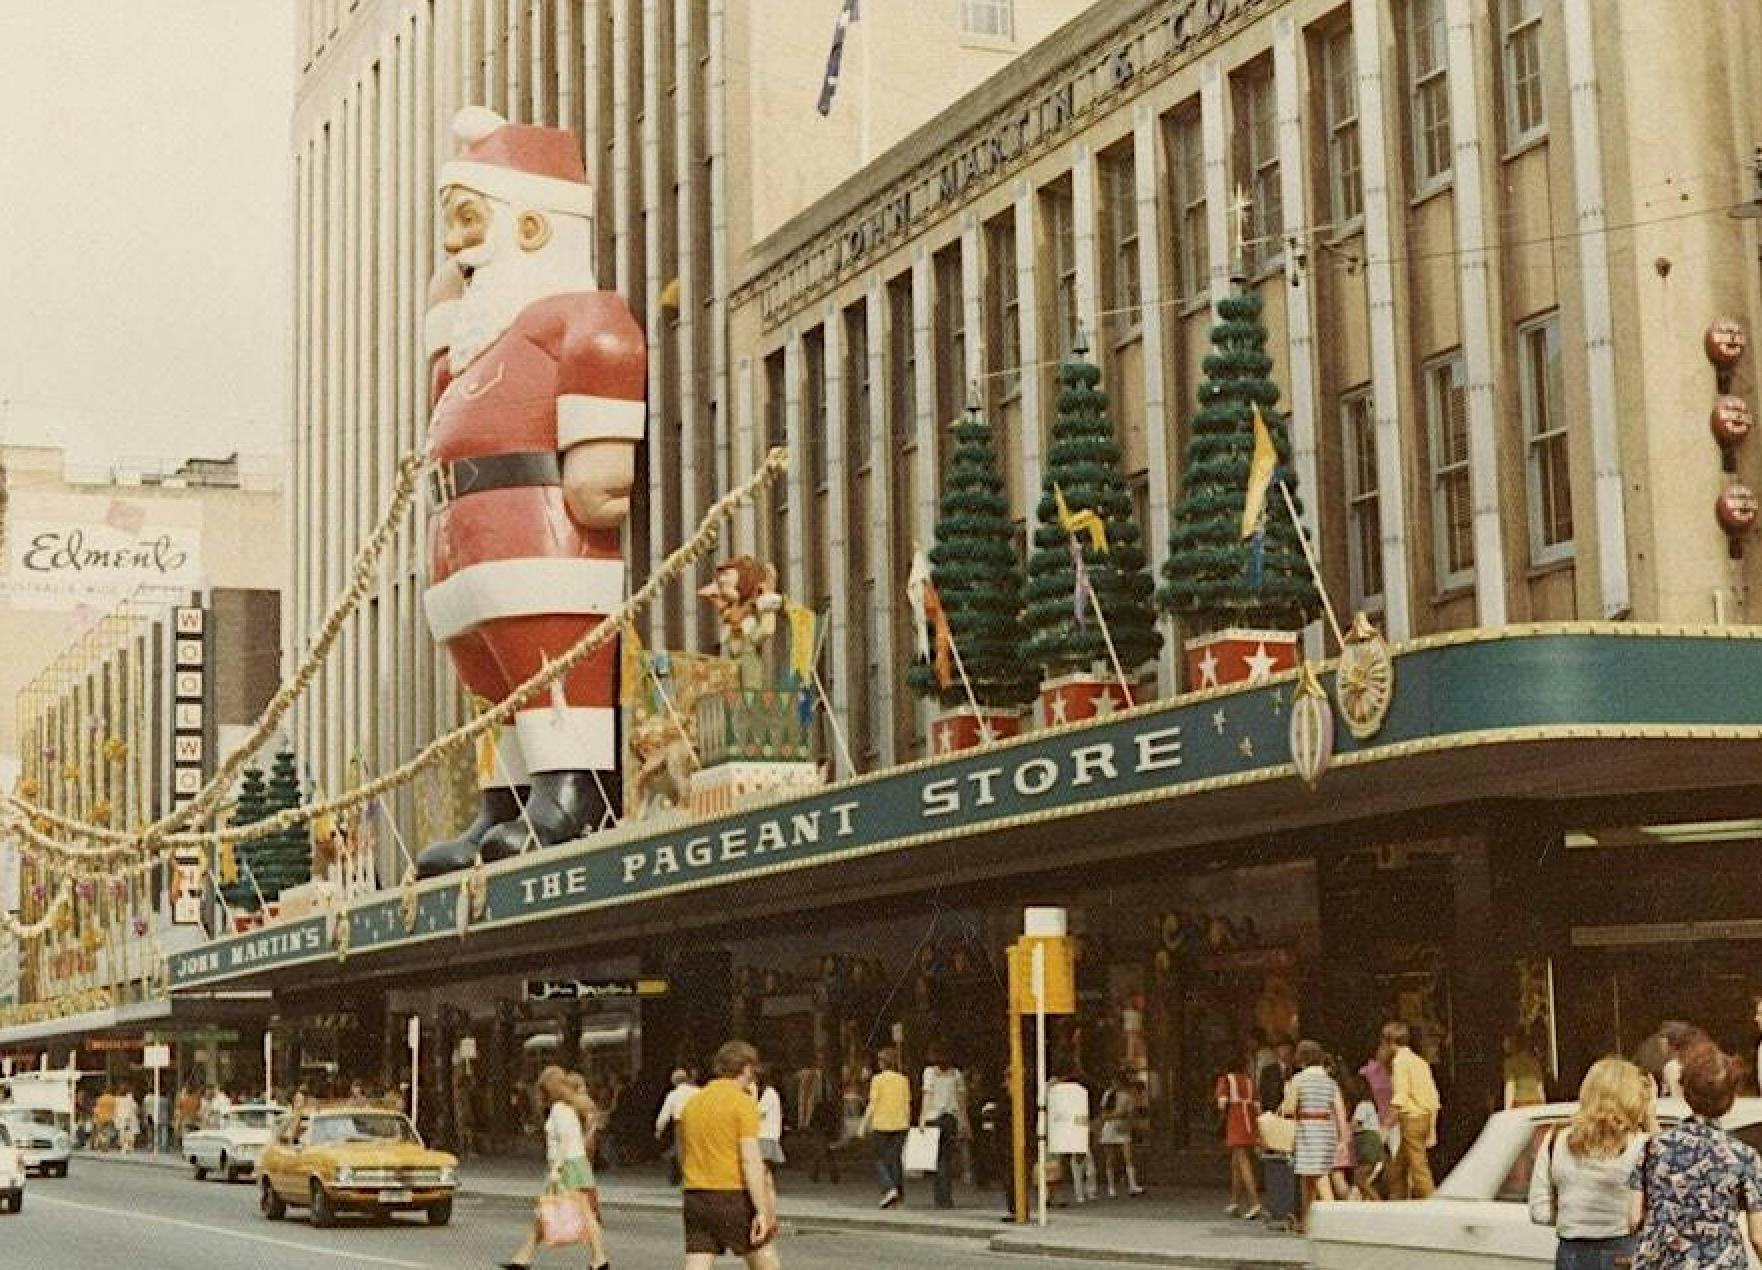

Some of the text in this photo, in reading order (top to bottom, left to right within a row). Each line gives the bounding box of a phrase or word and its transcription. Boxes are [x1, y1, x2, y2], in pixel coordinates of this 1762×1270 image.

[834, 191, 910, 269] JOHN
[937, 84, 1074, 198] MARTIN
[520, 726, 1183, 904] THE PAGEANT STORE
[177, 926, 321, 978] JOHN MARTIN'S
